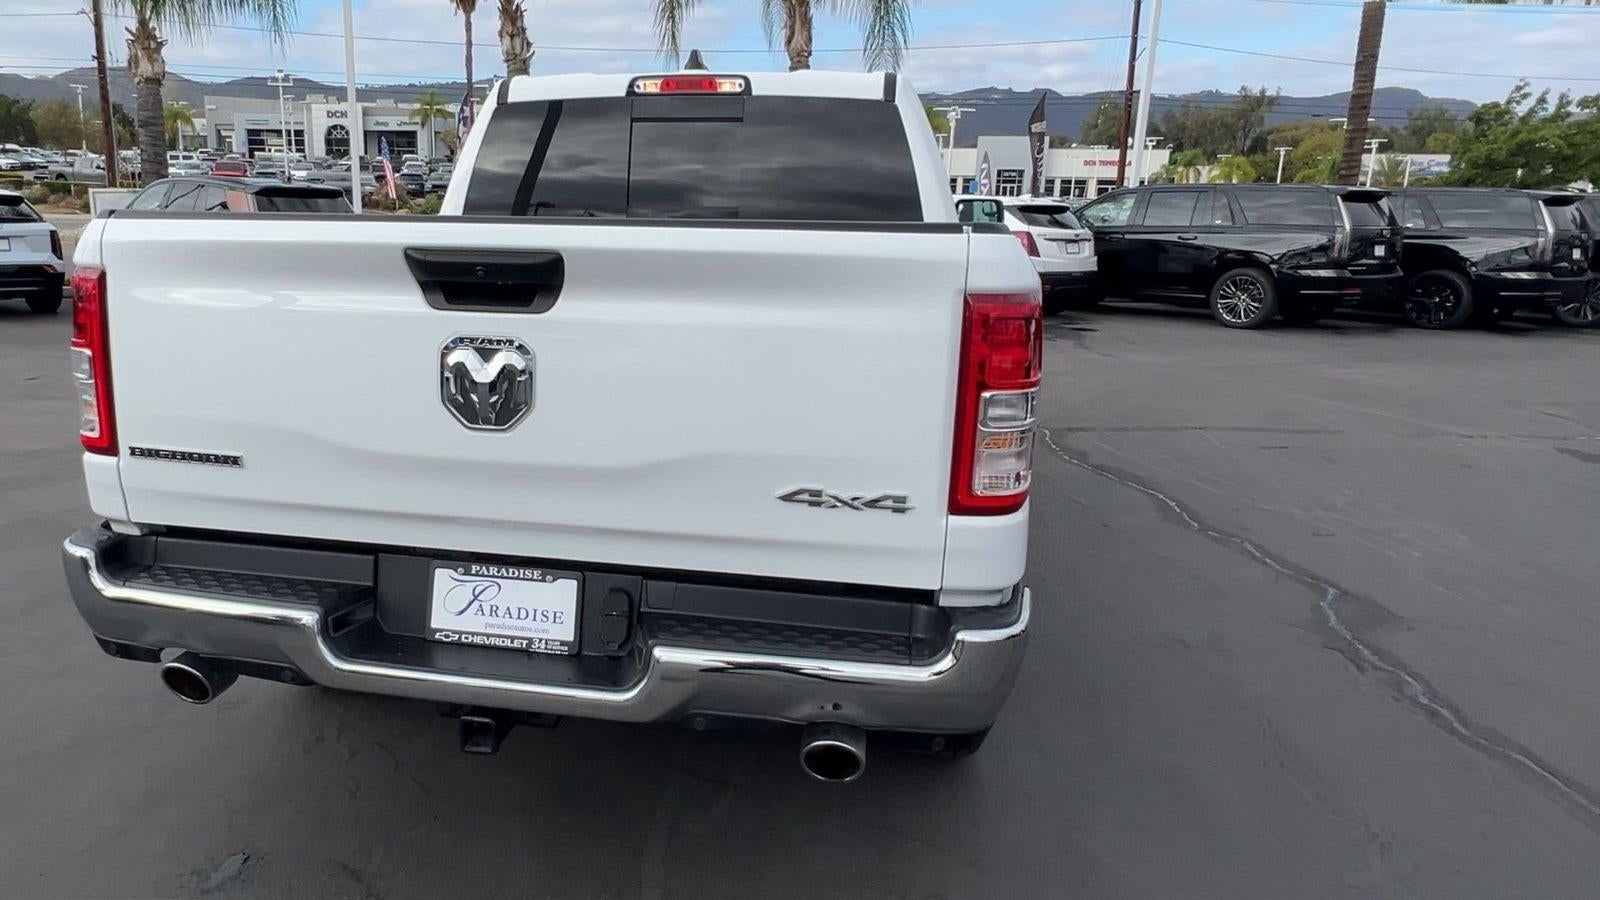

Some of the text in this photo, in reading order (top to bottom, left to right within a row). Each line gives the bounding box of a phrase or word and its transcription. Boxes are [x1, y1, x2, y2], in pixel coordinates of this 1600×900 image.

[326, 110, 348, 118] DCH
[459, 337, 519, 348] RAM
[128, 446, 243, 468] BIGHORN
[470, 564, 543, 580] PARADISE
[484, 621, 550, 635] paradiseautos.com
[461, 633, 529, 649] CHEVROLET
[531, 637, 547, 650] 34
